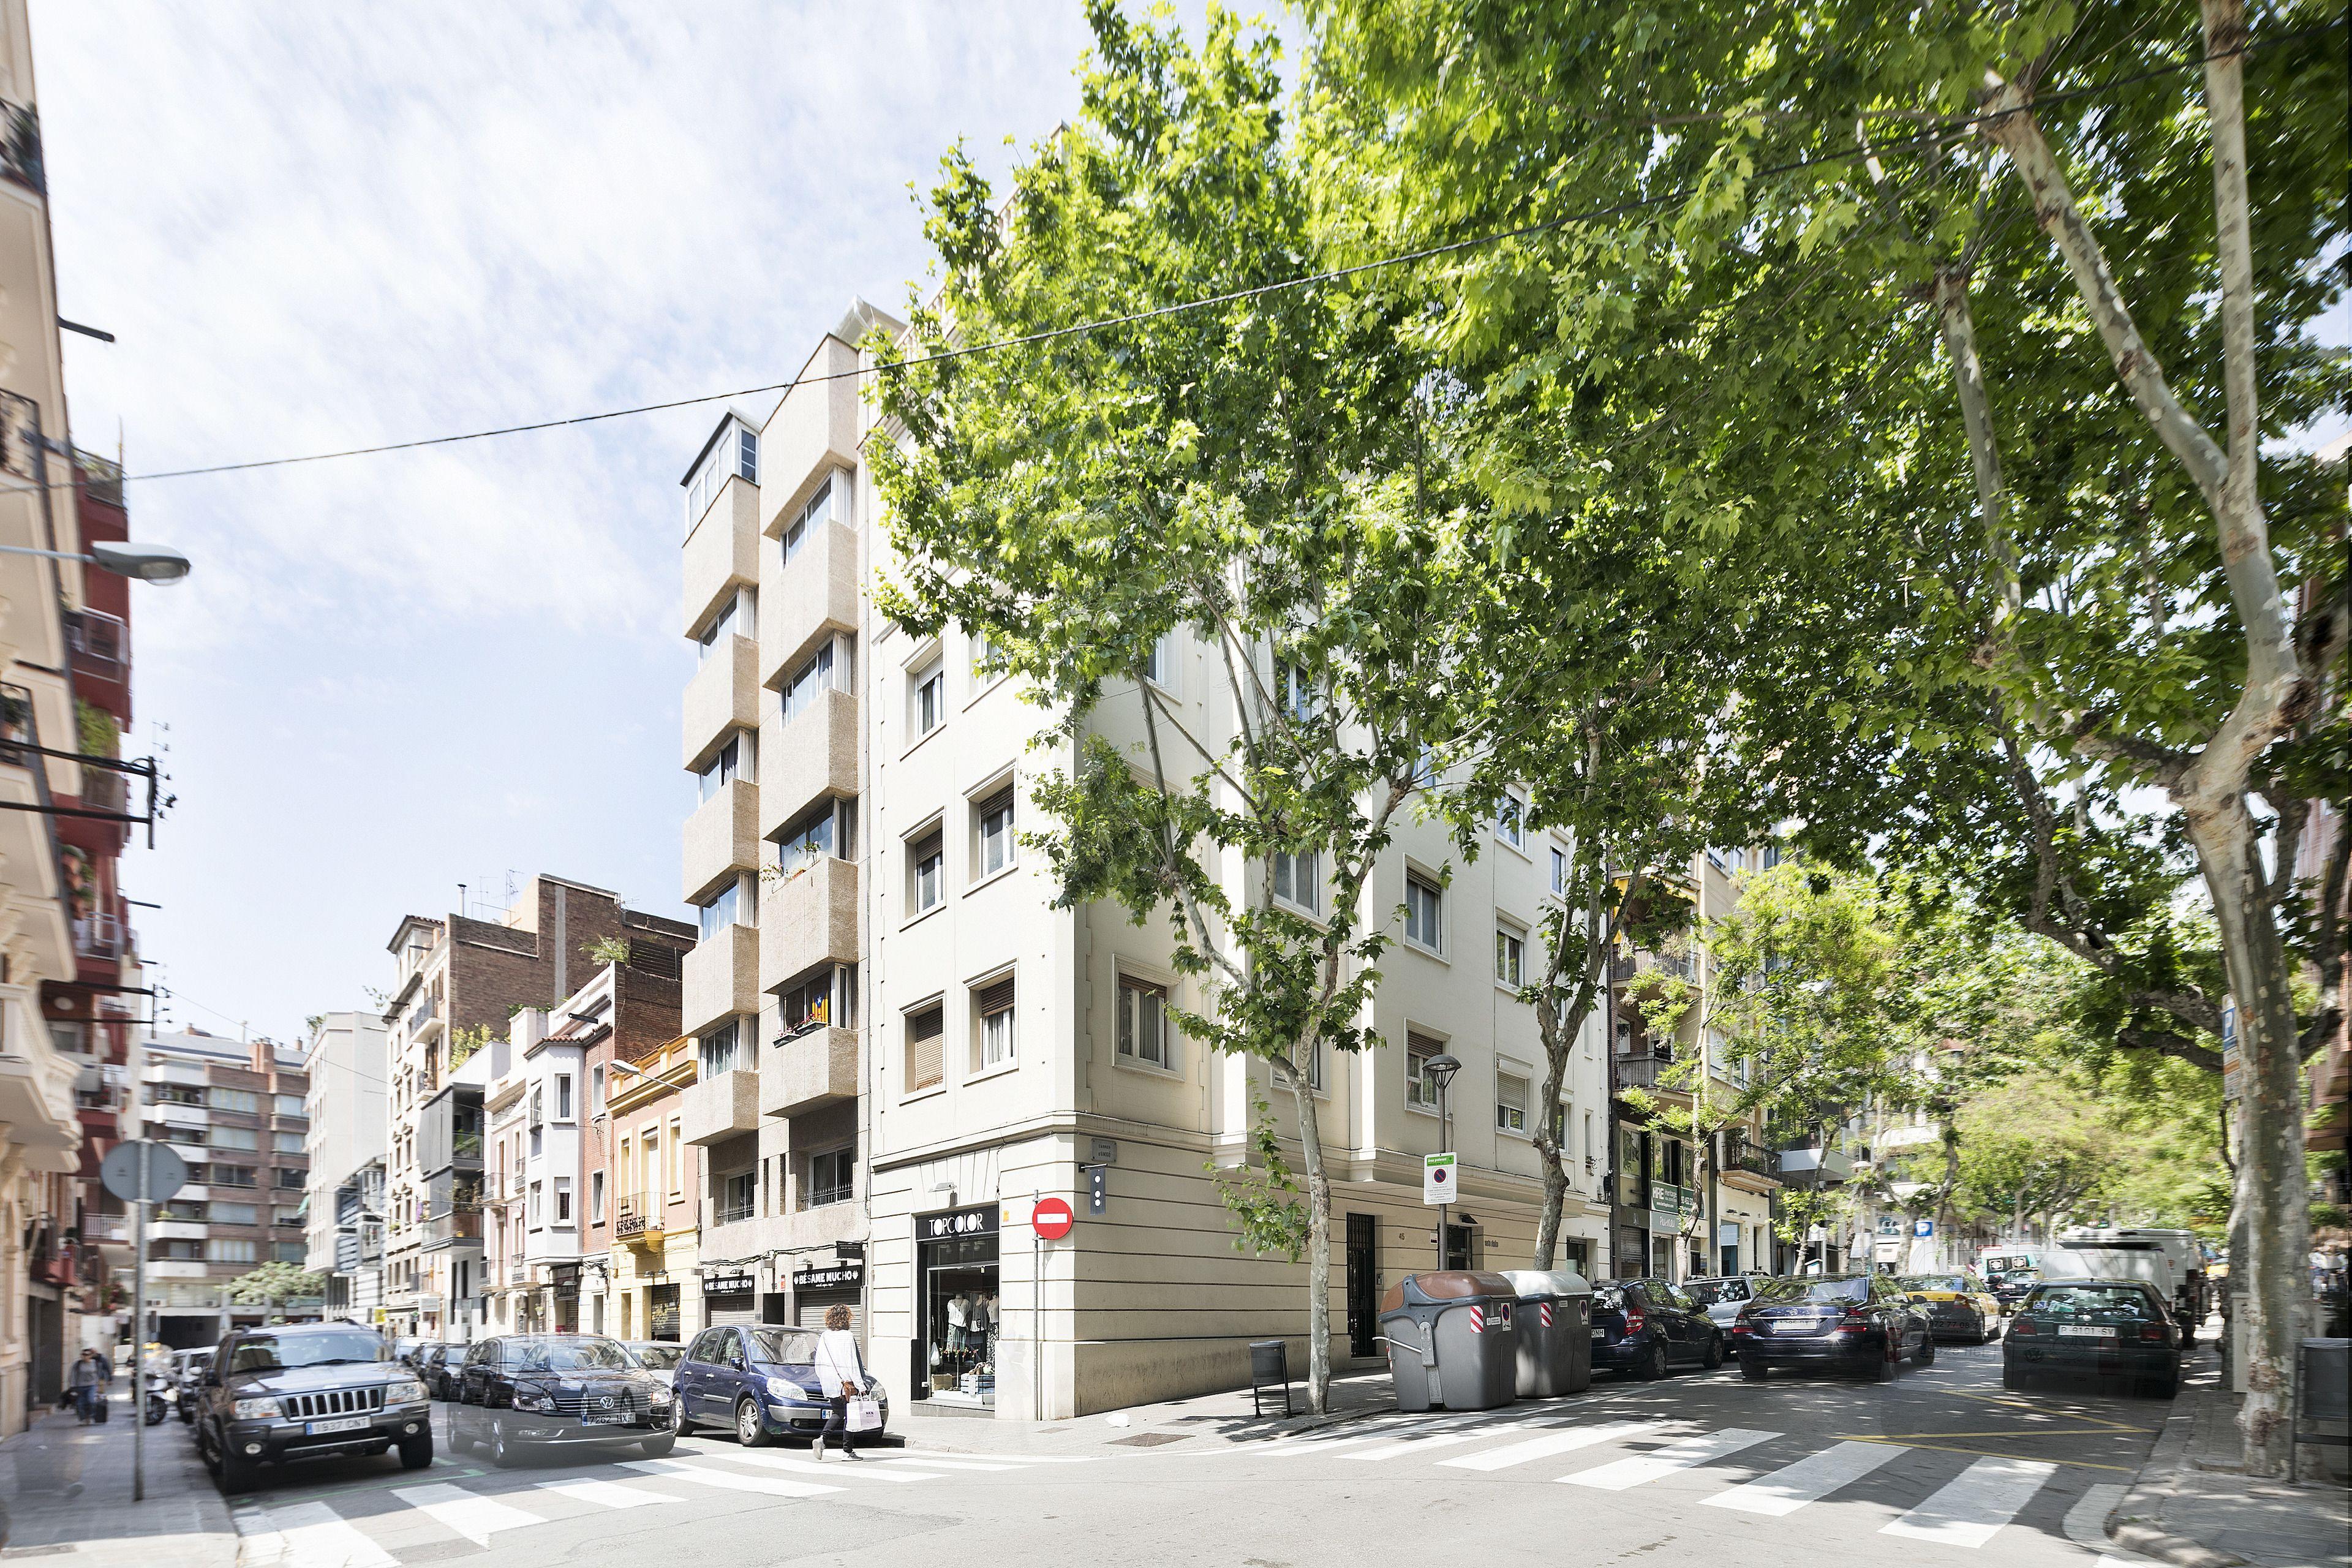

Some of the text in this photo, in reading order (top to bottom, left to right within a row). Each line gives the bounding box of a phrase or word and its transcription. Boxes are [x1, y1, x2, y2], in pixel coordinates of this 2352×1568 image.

[1653, 1186, 1664, 1200] HRE
[929, 1213, 983, 1236] TOPCOLOR
[799, 1273, 825, 1284] BÉSAME
[826, 1270, 852, 1282] MUCHO
[709, 1280, 747, 1291] BÉSAME MUCHO
